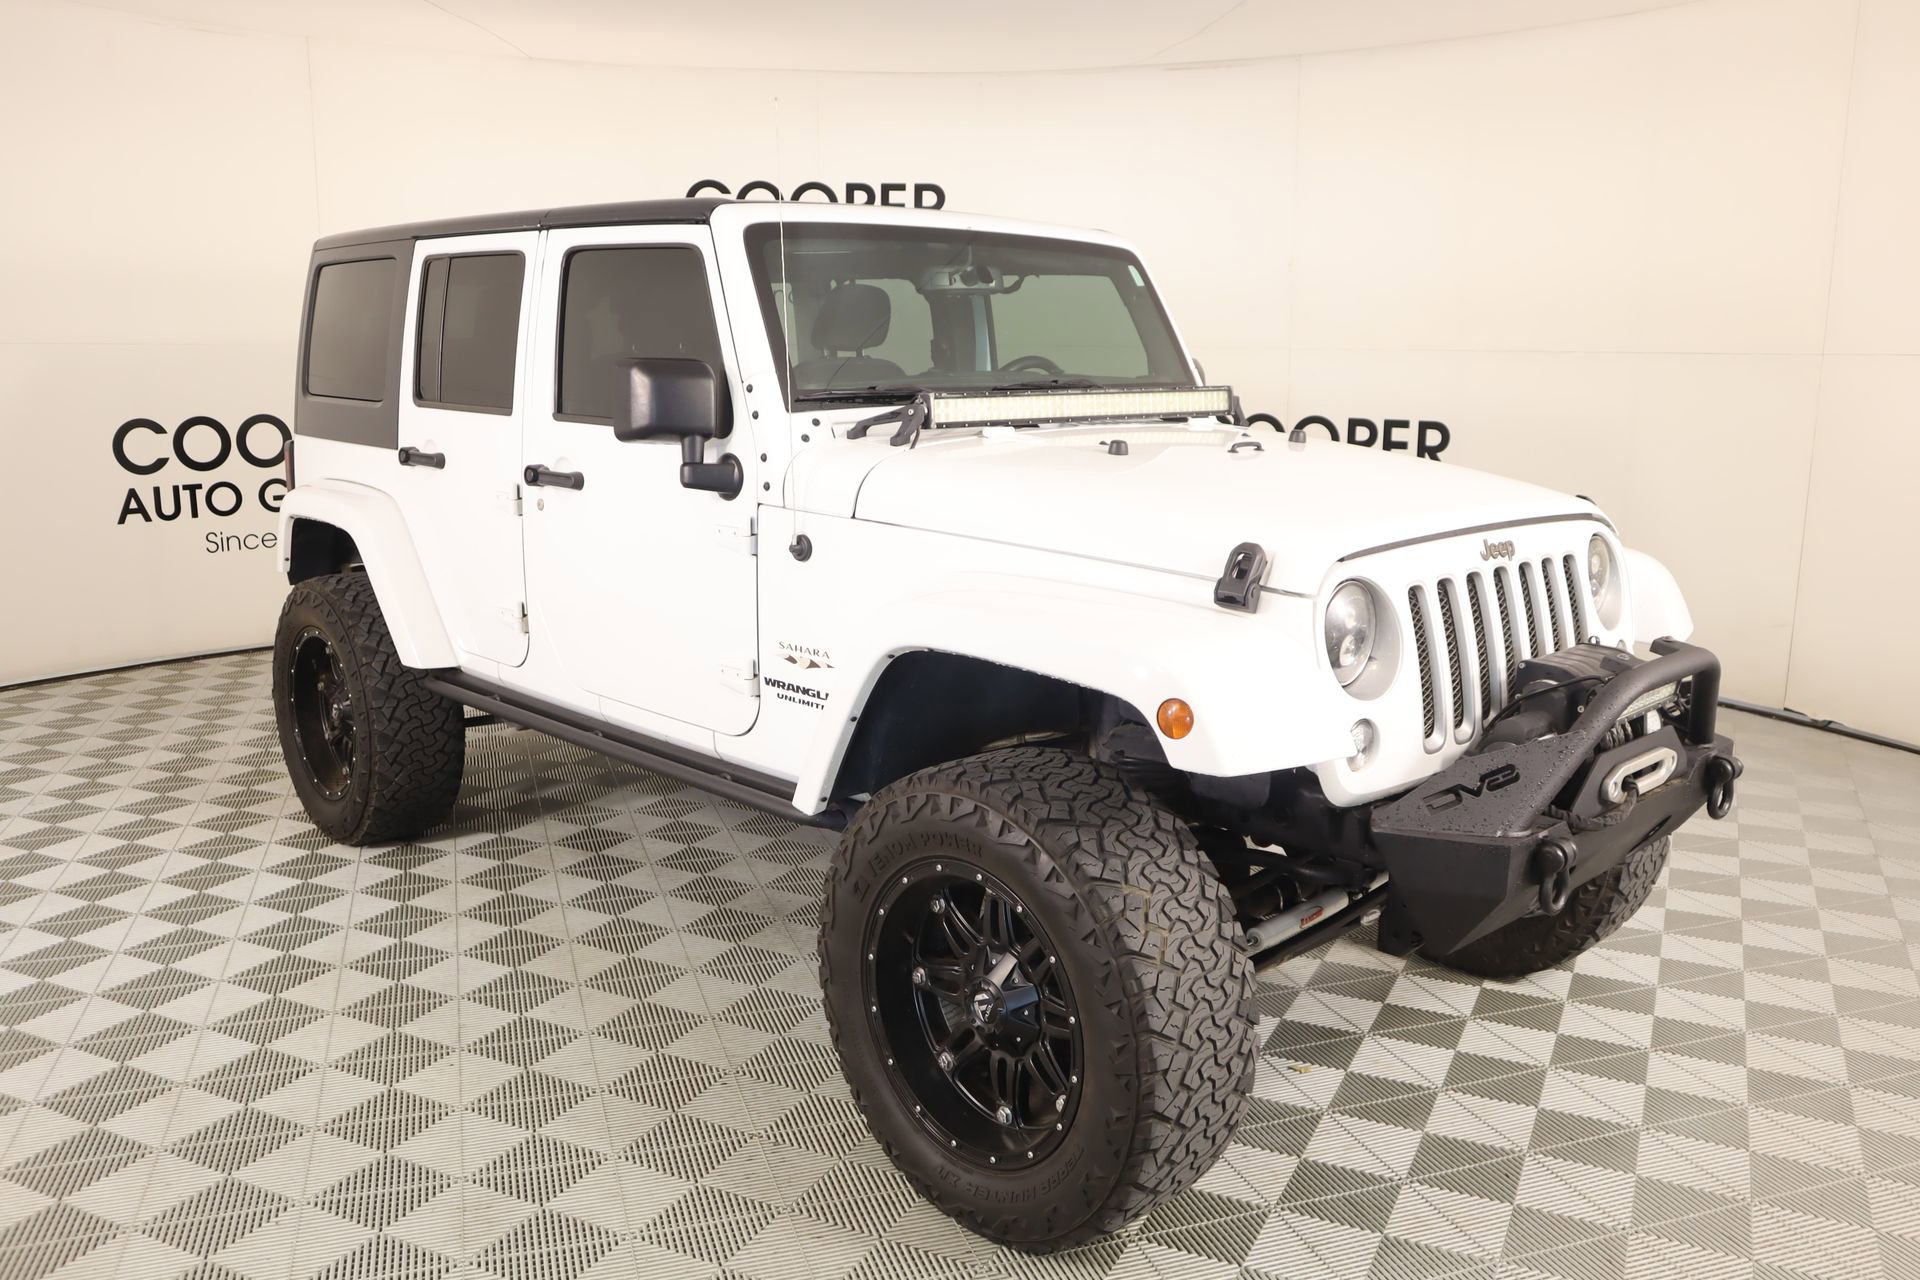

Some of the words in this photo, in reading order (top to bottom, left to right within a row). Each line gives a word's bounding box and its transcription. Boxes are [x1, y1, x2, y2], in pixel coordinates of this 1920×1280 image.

[117, 481, 243, 525] AUTO
[205, 531, 278, 553] Since
[1480, 538, 1516, 561] Jeep
[778, 640, 831, 660] SAHARA
